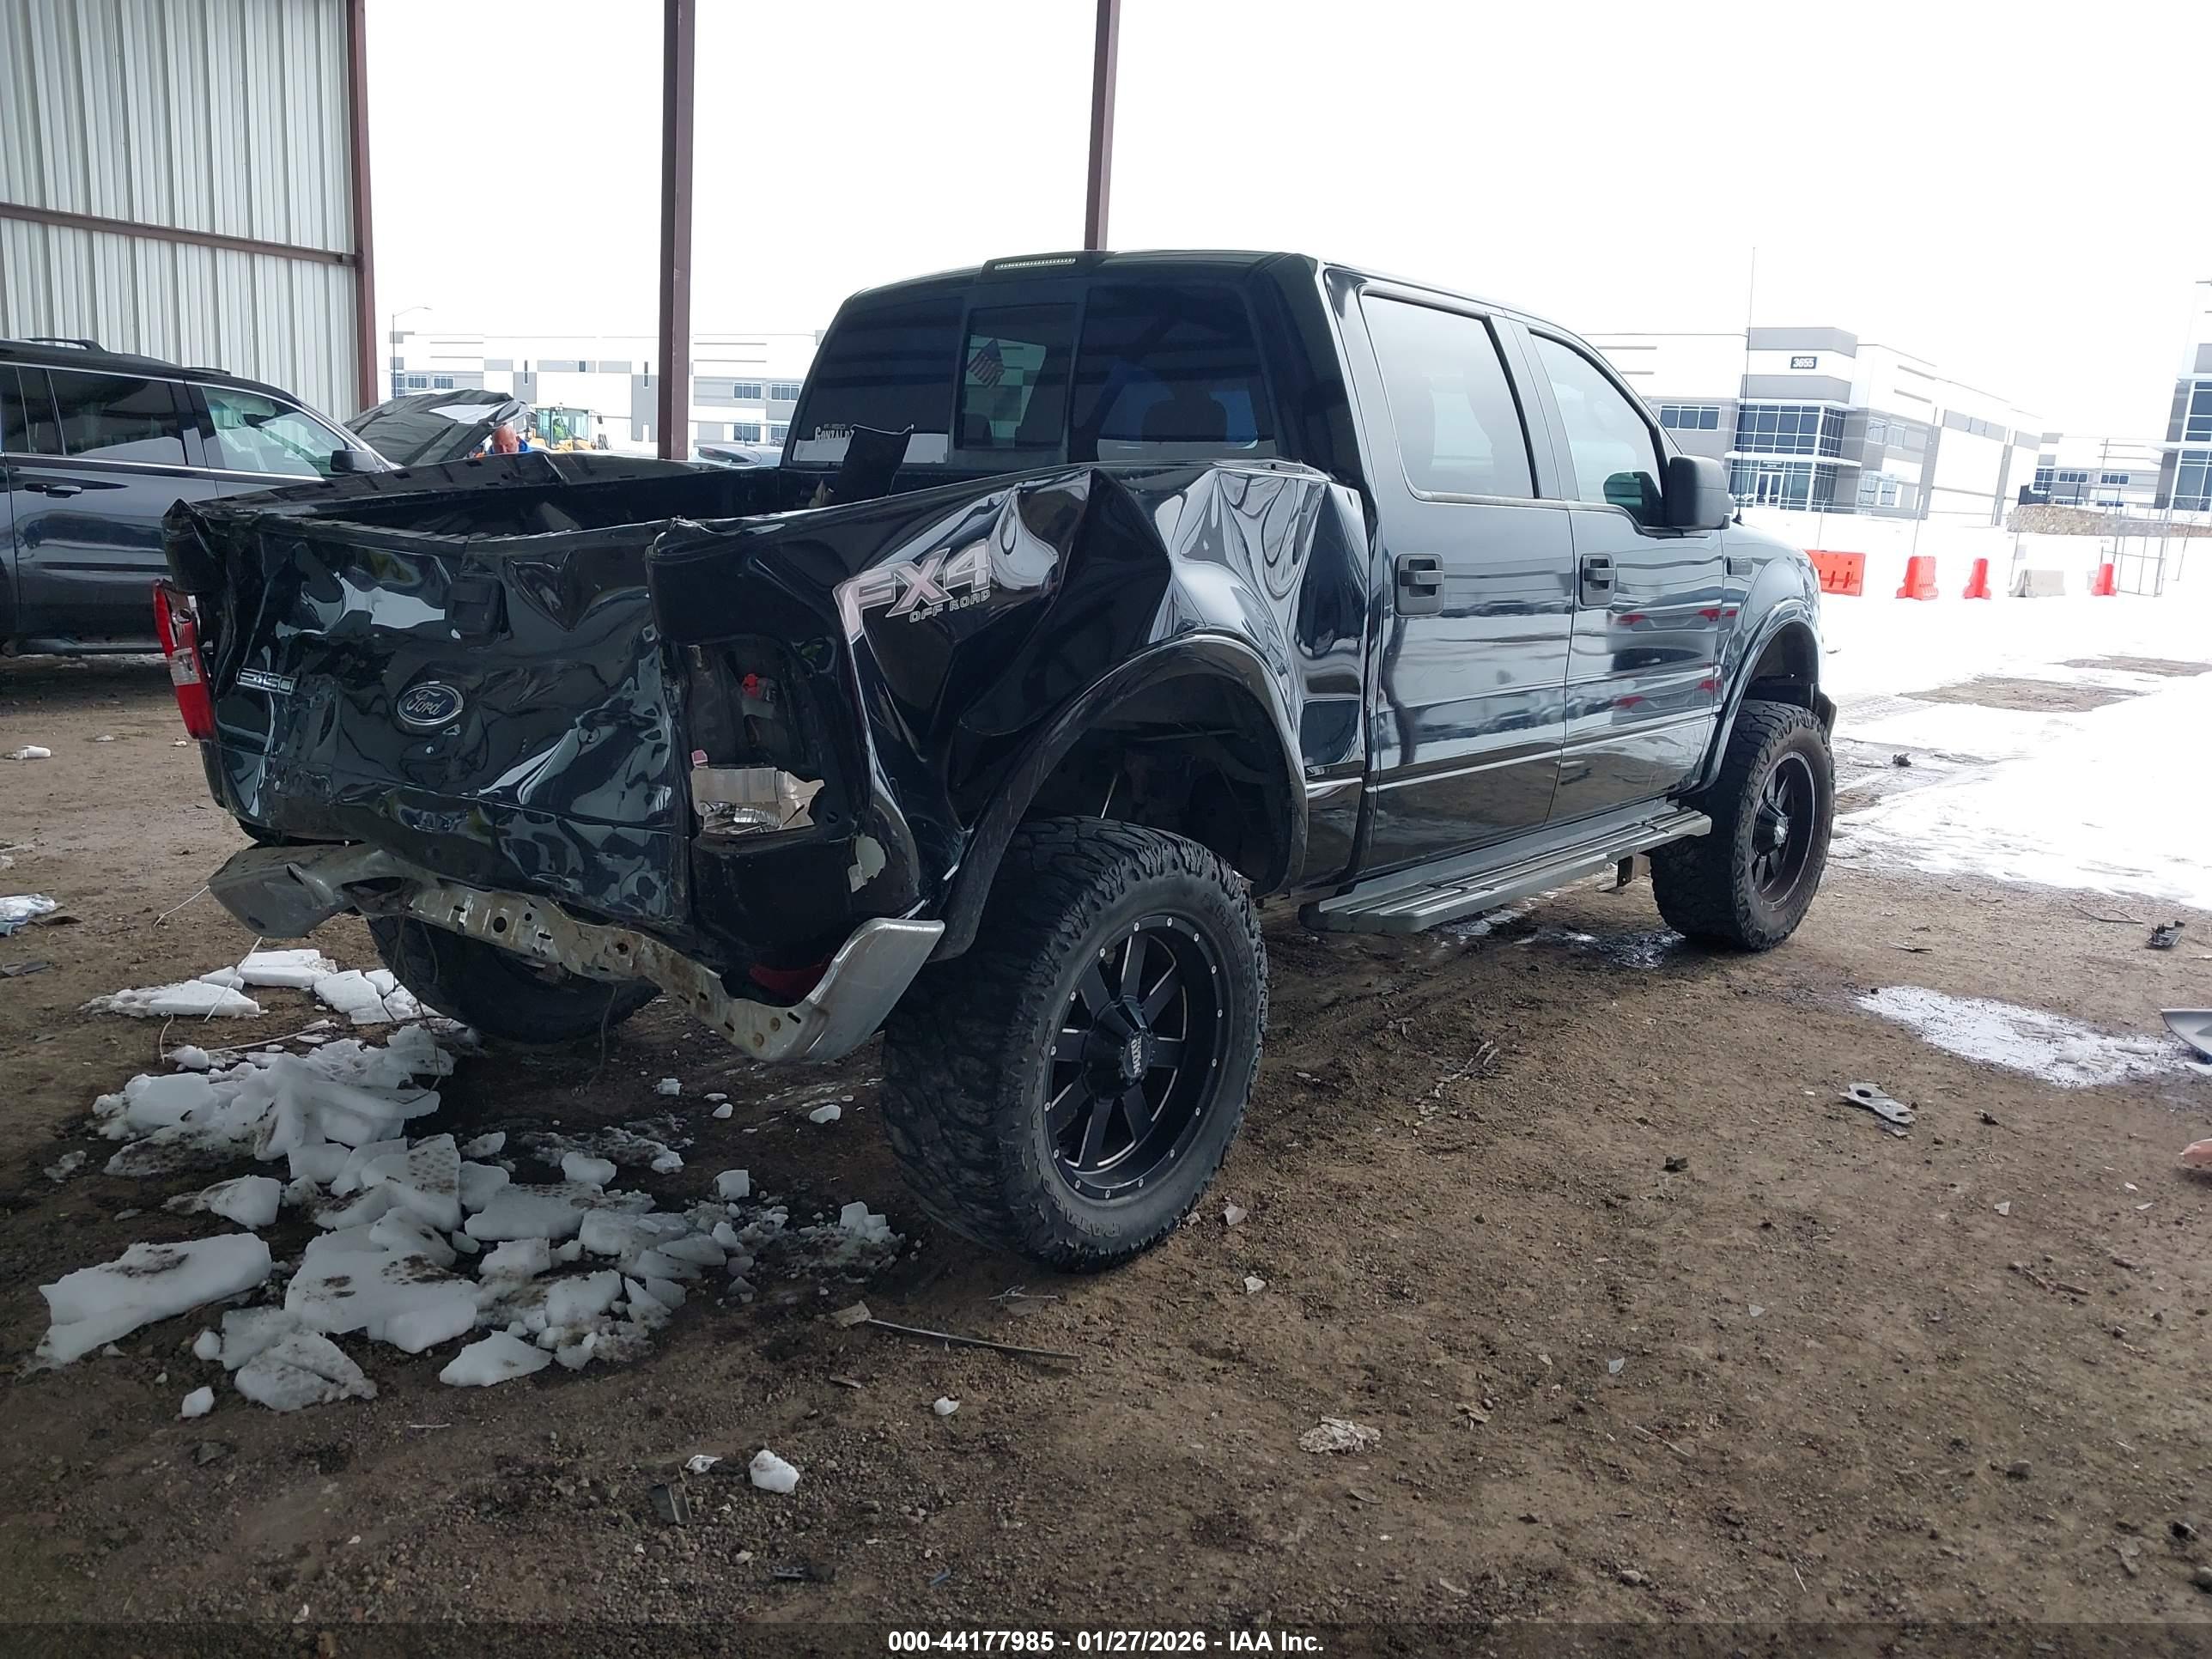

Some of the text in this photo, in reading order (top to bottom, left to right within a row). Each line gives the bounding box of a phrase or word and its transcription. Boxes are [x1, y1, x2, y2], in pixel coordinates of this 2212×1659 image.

[1793, 357, 1814, 368] 3655
[832, 538, 992, 644] FX4
[908, 589, 991, 623] OFF ROAD
[405, 689, 447, 716] Ford
